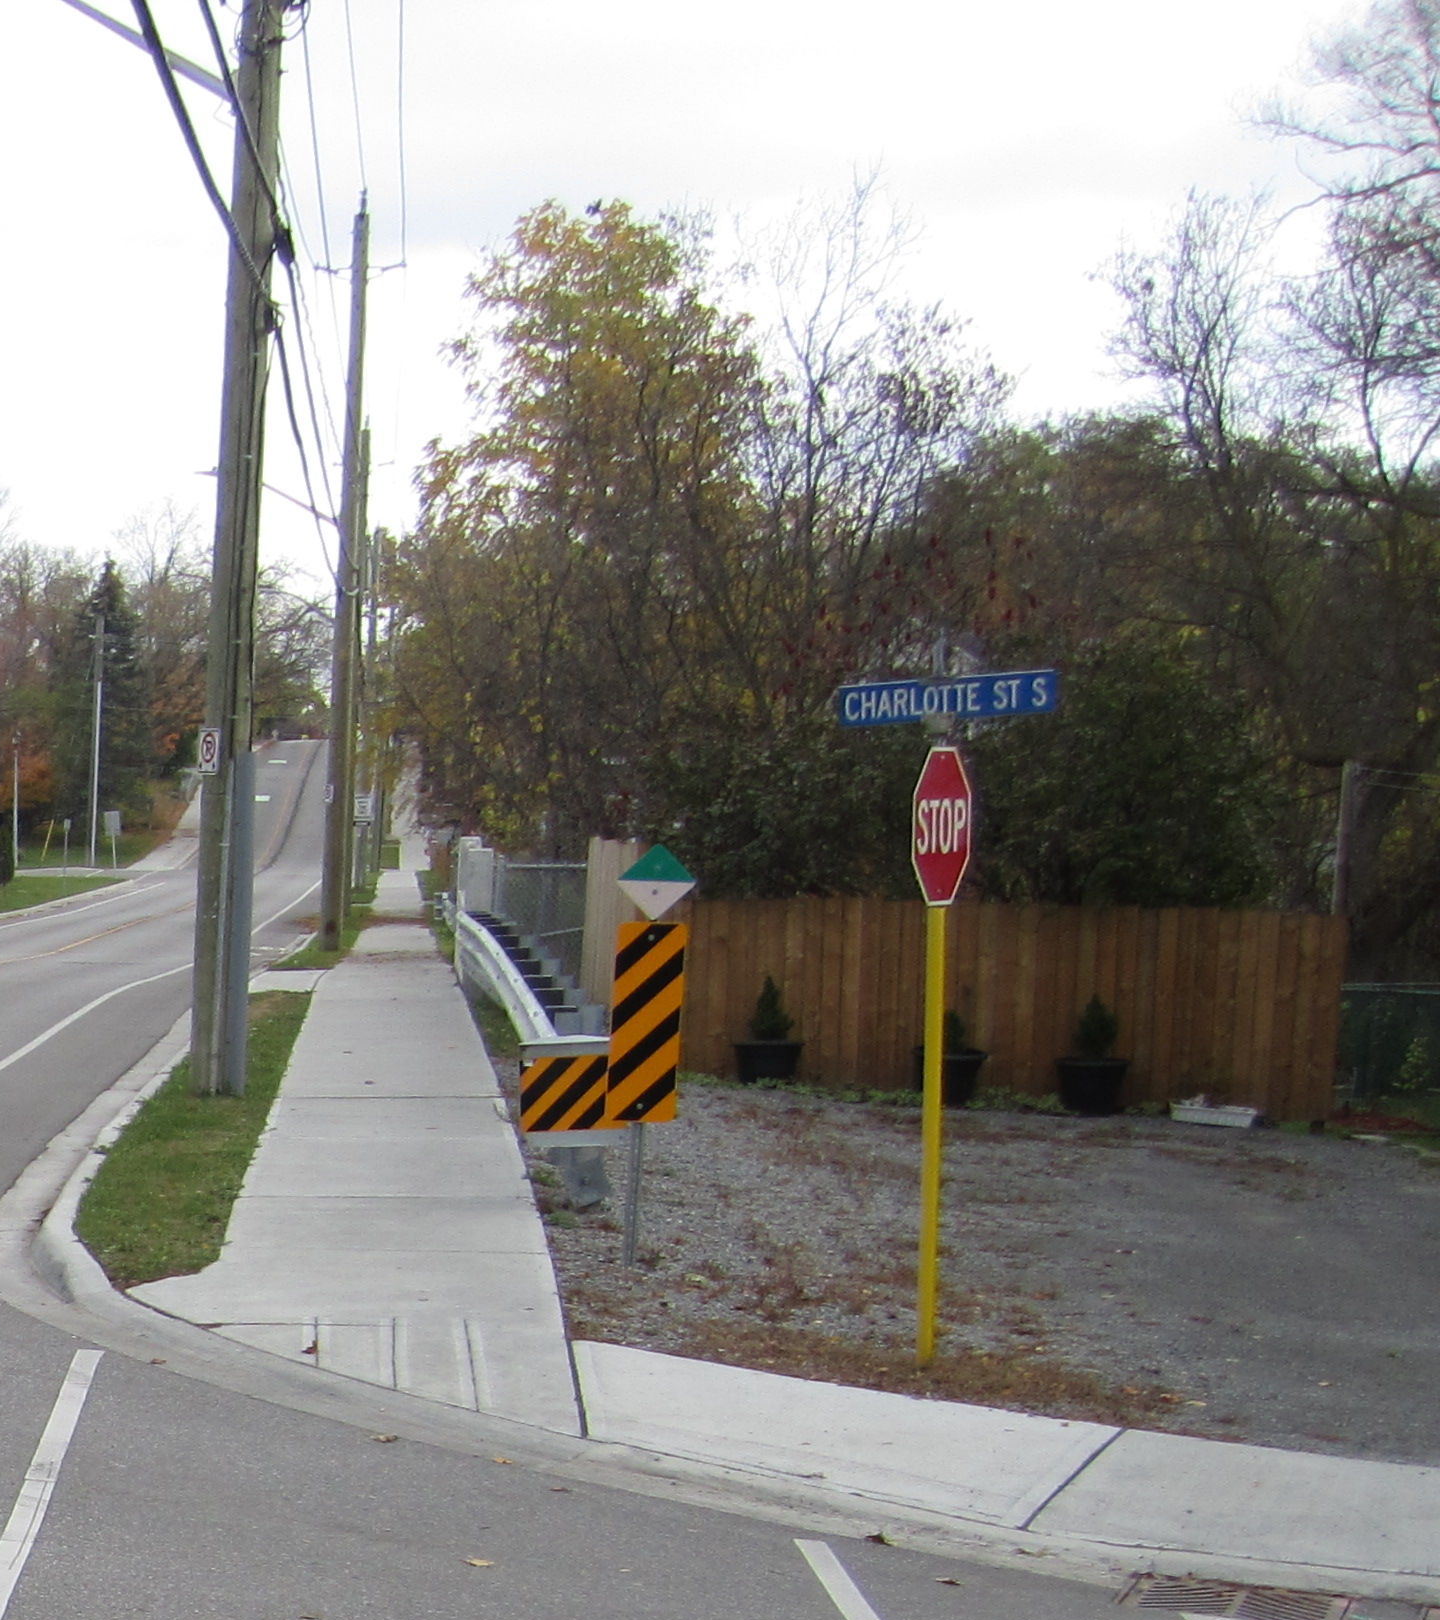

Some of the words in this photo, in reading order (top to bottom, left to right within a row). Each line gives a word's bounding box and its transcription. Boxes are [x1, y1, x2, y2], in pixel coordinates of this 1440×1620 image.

[844, 683, 980, 721] CHARLOTTE
[993, 680, 1020, 710] ST
[1031, 678, 1047, 707] S
[917, 798, 967, 855] STOP
